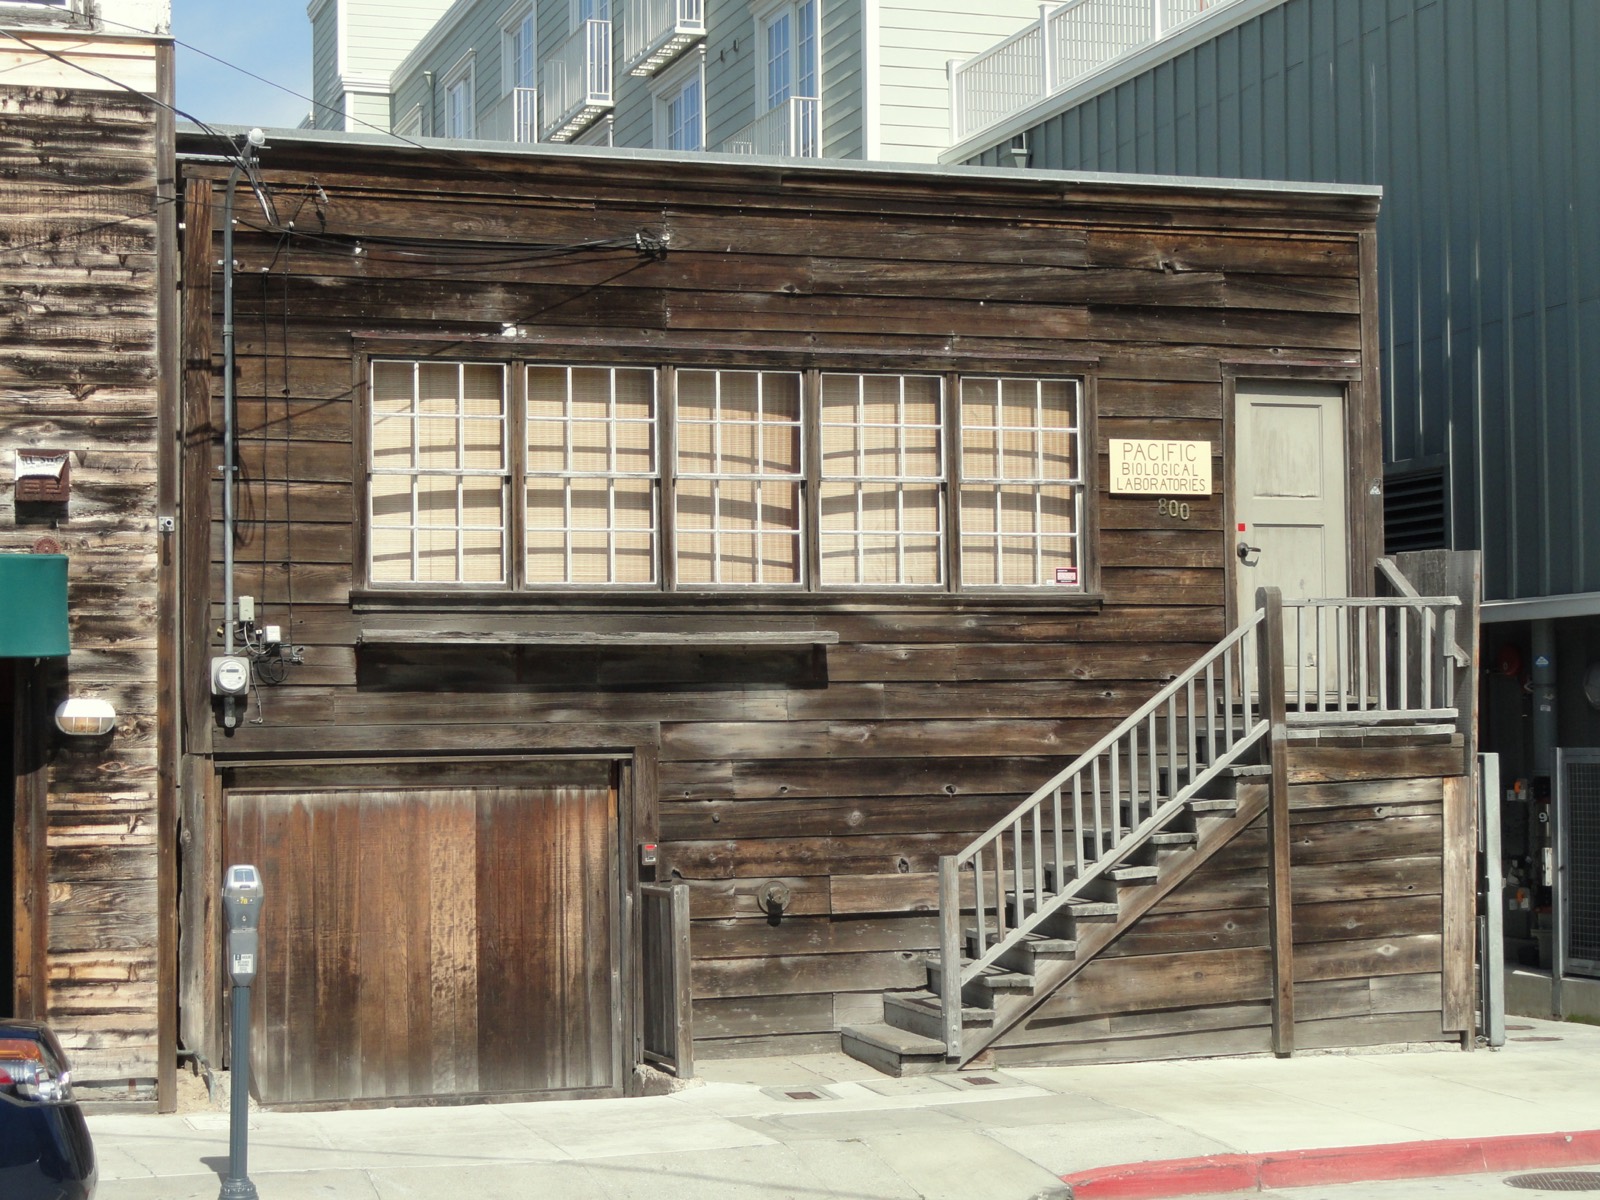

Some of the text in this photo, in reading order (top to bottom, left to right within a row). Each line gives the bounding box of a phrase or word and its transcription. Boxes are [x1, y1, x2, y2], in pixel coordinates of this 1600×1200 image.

[1122, 442, 1197, 462] PACIFIC
[1121, 462, 1199, 477] BIOLOGICAL
[1116, 477, 1206, 492] LABORATORIES
[1158, 497, 1190, 521] 800
[1538, 812, 1548, 822] 9
